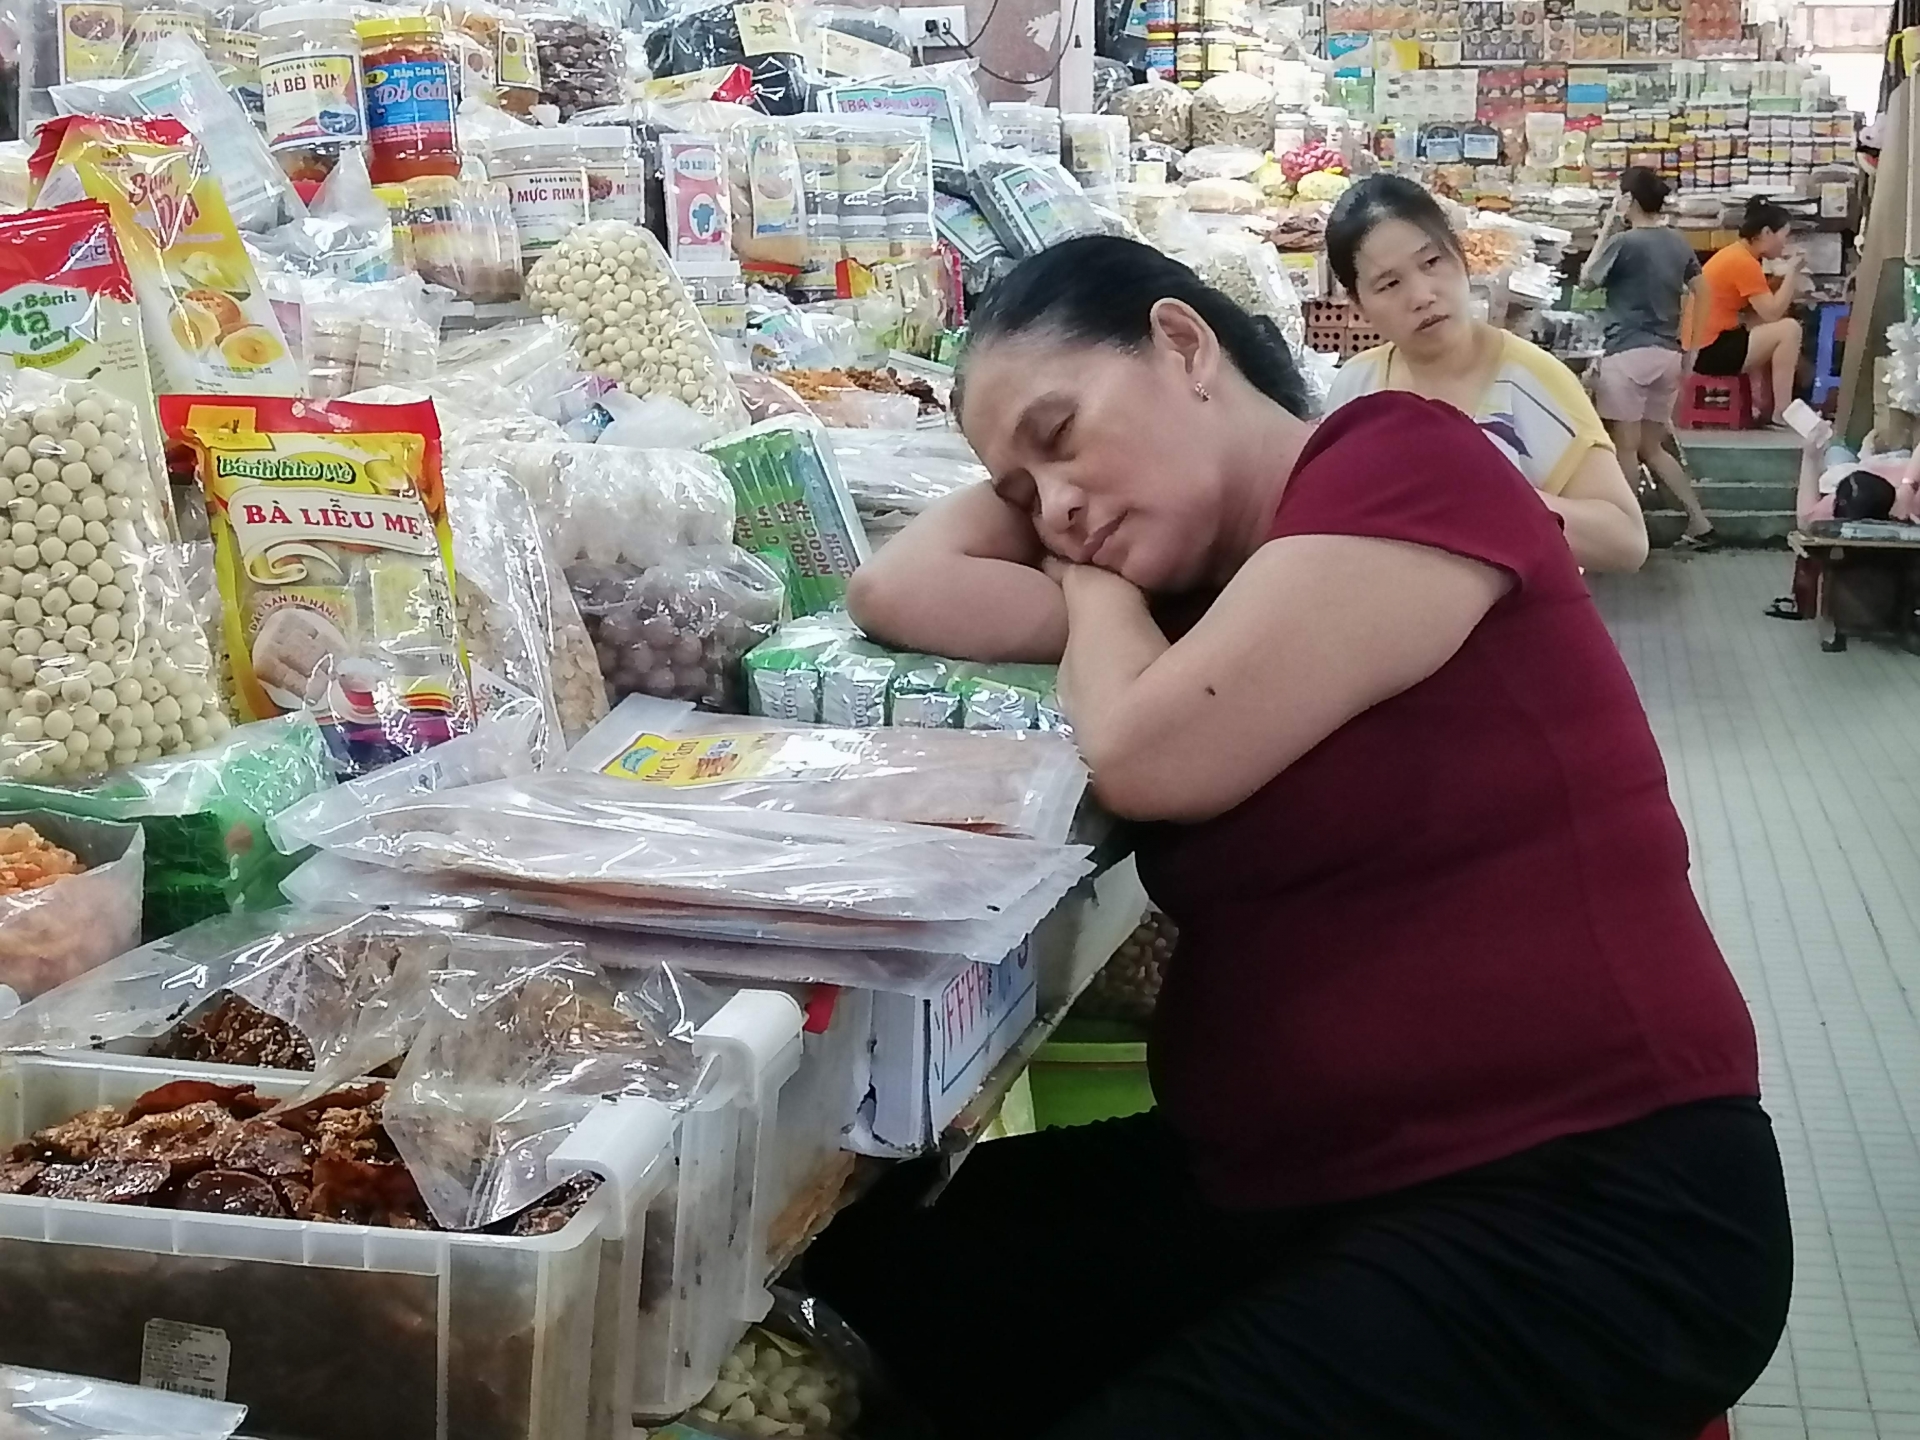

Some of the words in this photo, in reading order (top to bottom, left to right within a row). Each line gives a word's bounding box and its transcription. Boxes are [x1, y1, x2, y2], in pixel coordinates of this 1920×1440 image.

[517, 186, 548, 204] MỰC
[552, 188, 576, 201] RIM
[23, 289, 77, 310] Bánh
[217, 456, 273, 479] Bánh
[243, 501, 293, 525] BÀ
[298, 498, 374, 529] LIỄU
[382, 512, 424, 540] MẸ
